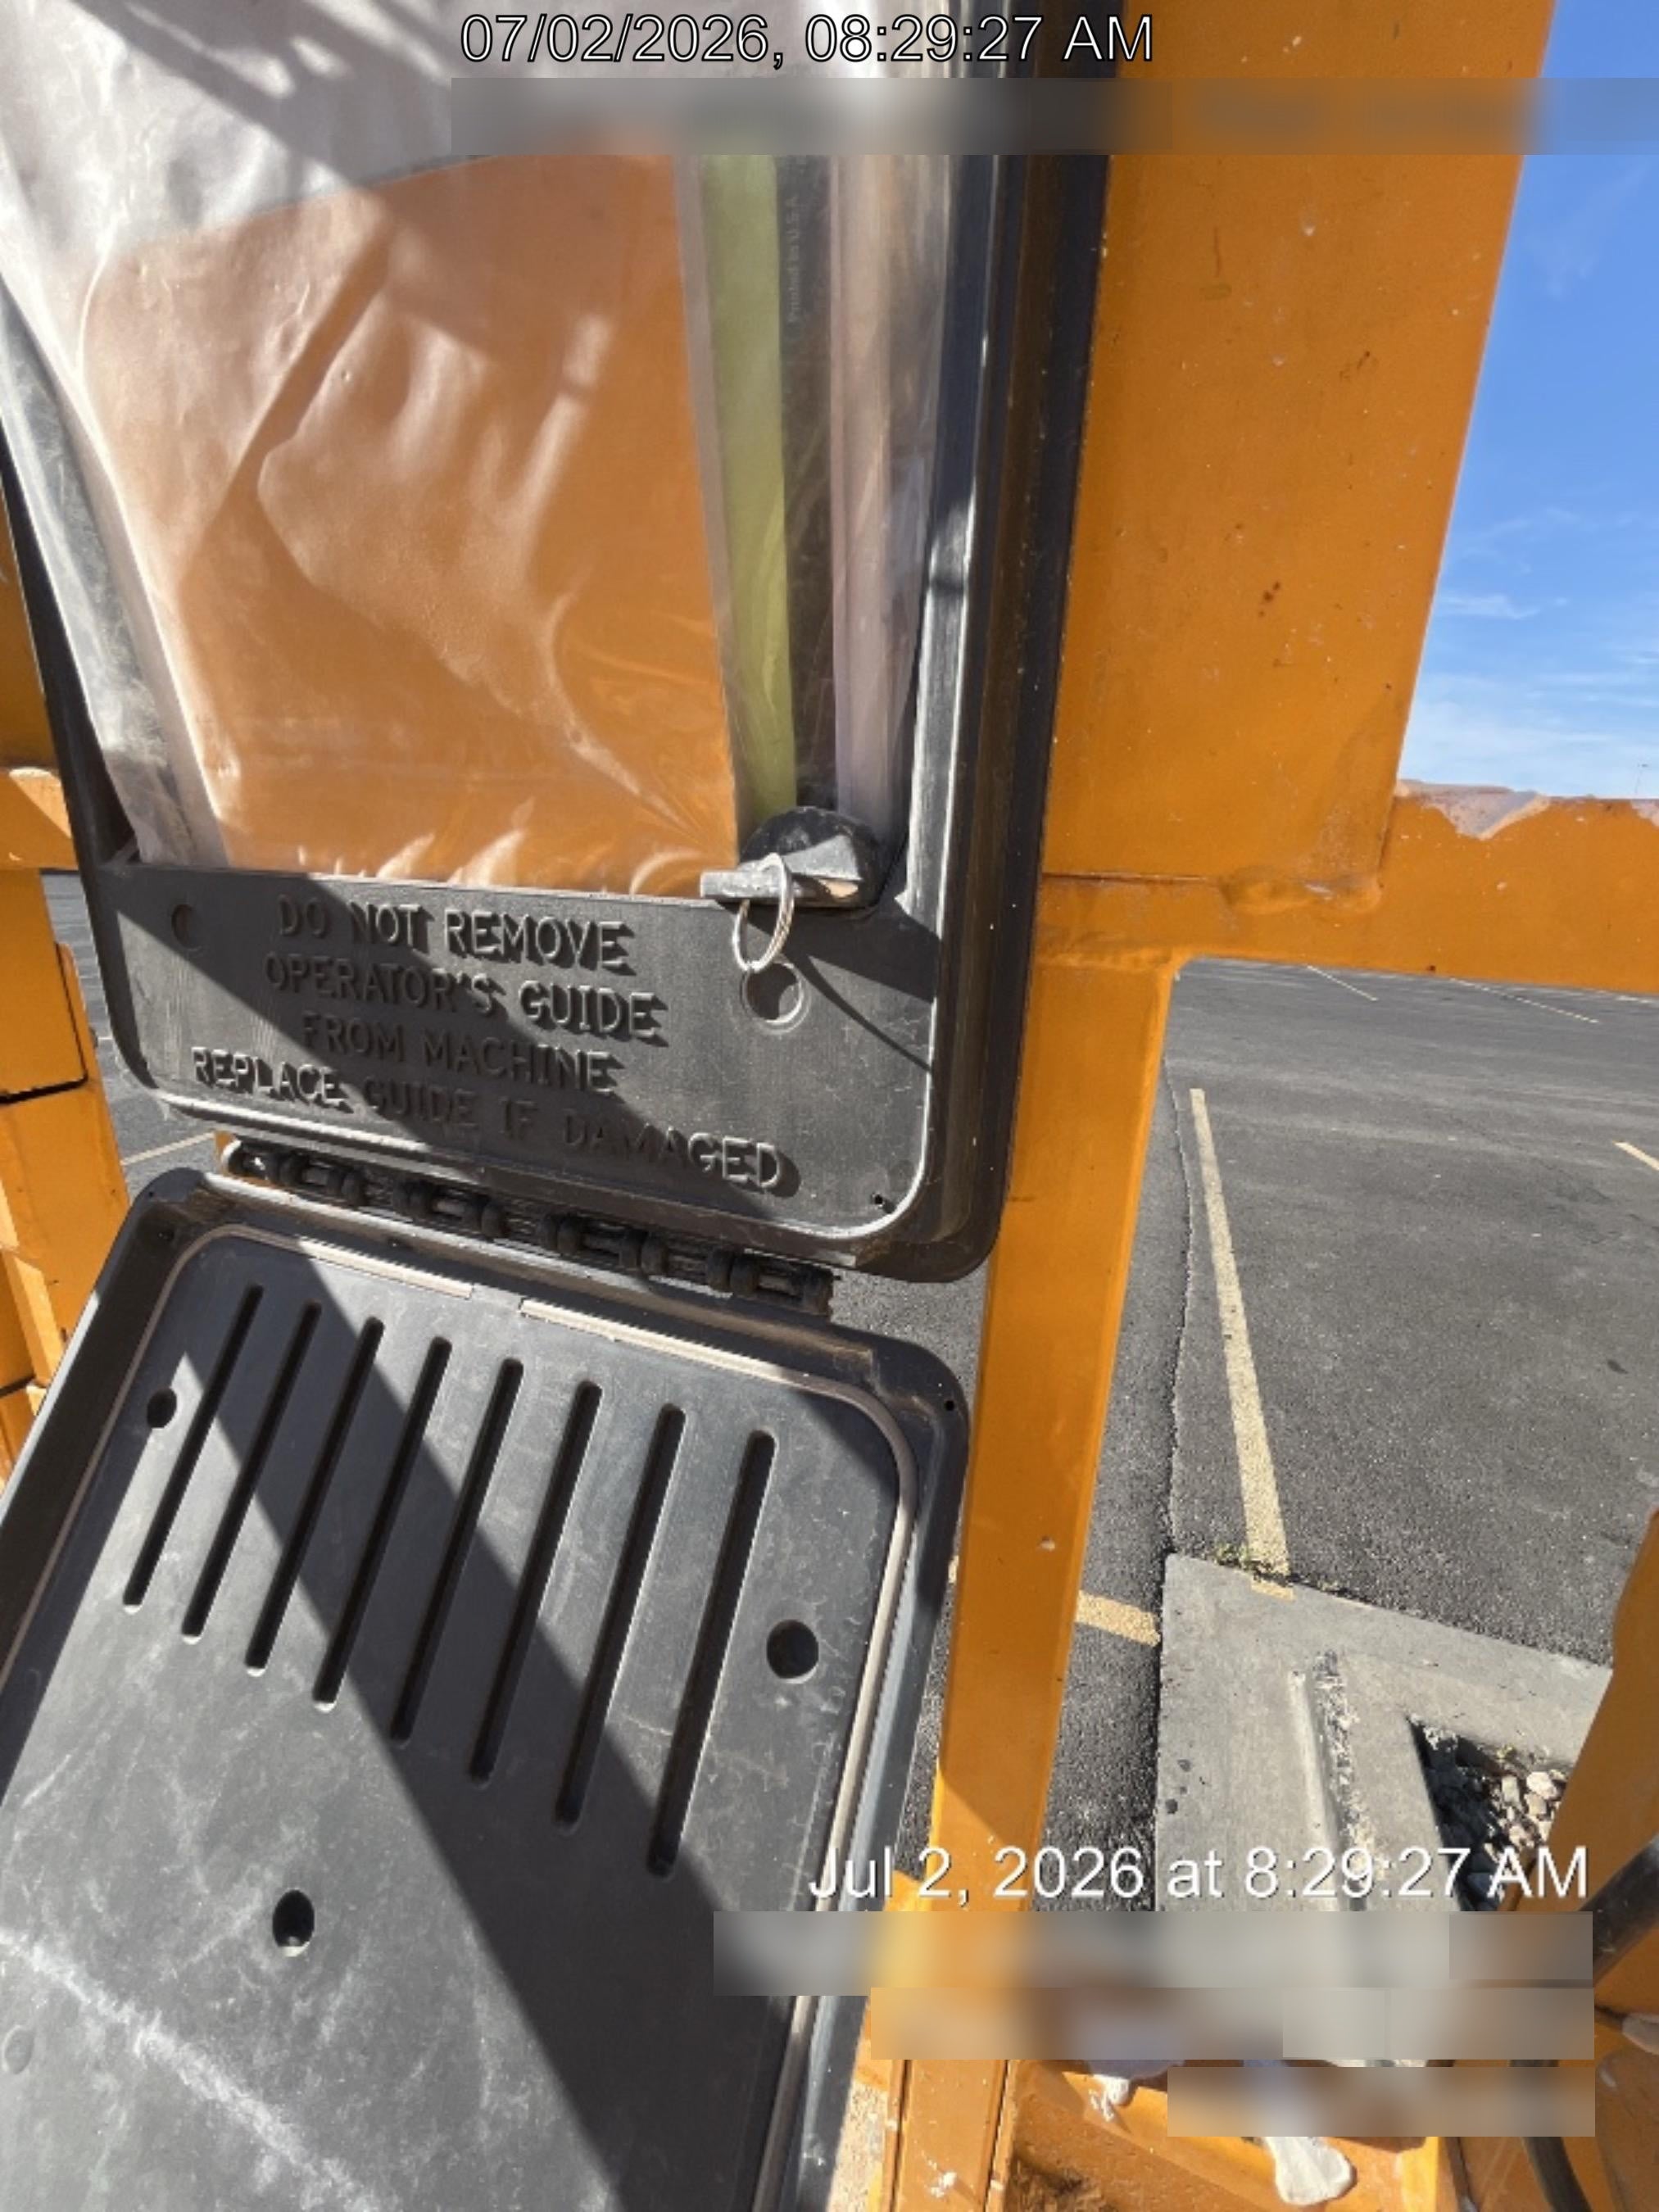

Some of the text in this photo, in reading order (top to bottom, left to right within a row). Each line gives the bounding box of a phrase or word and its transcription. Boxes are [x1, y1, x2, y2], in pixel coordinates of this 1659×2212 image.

[279, 895, 628, 970] DO NOT REMOVE
[264, 953, 659, 1039] OPERATOR'S GUIDE
[301, 1012, 618, 1096] FROM MACHINE
[191, 1045, 785, 1190] REPLACE GUIDE IF DAMAGED
